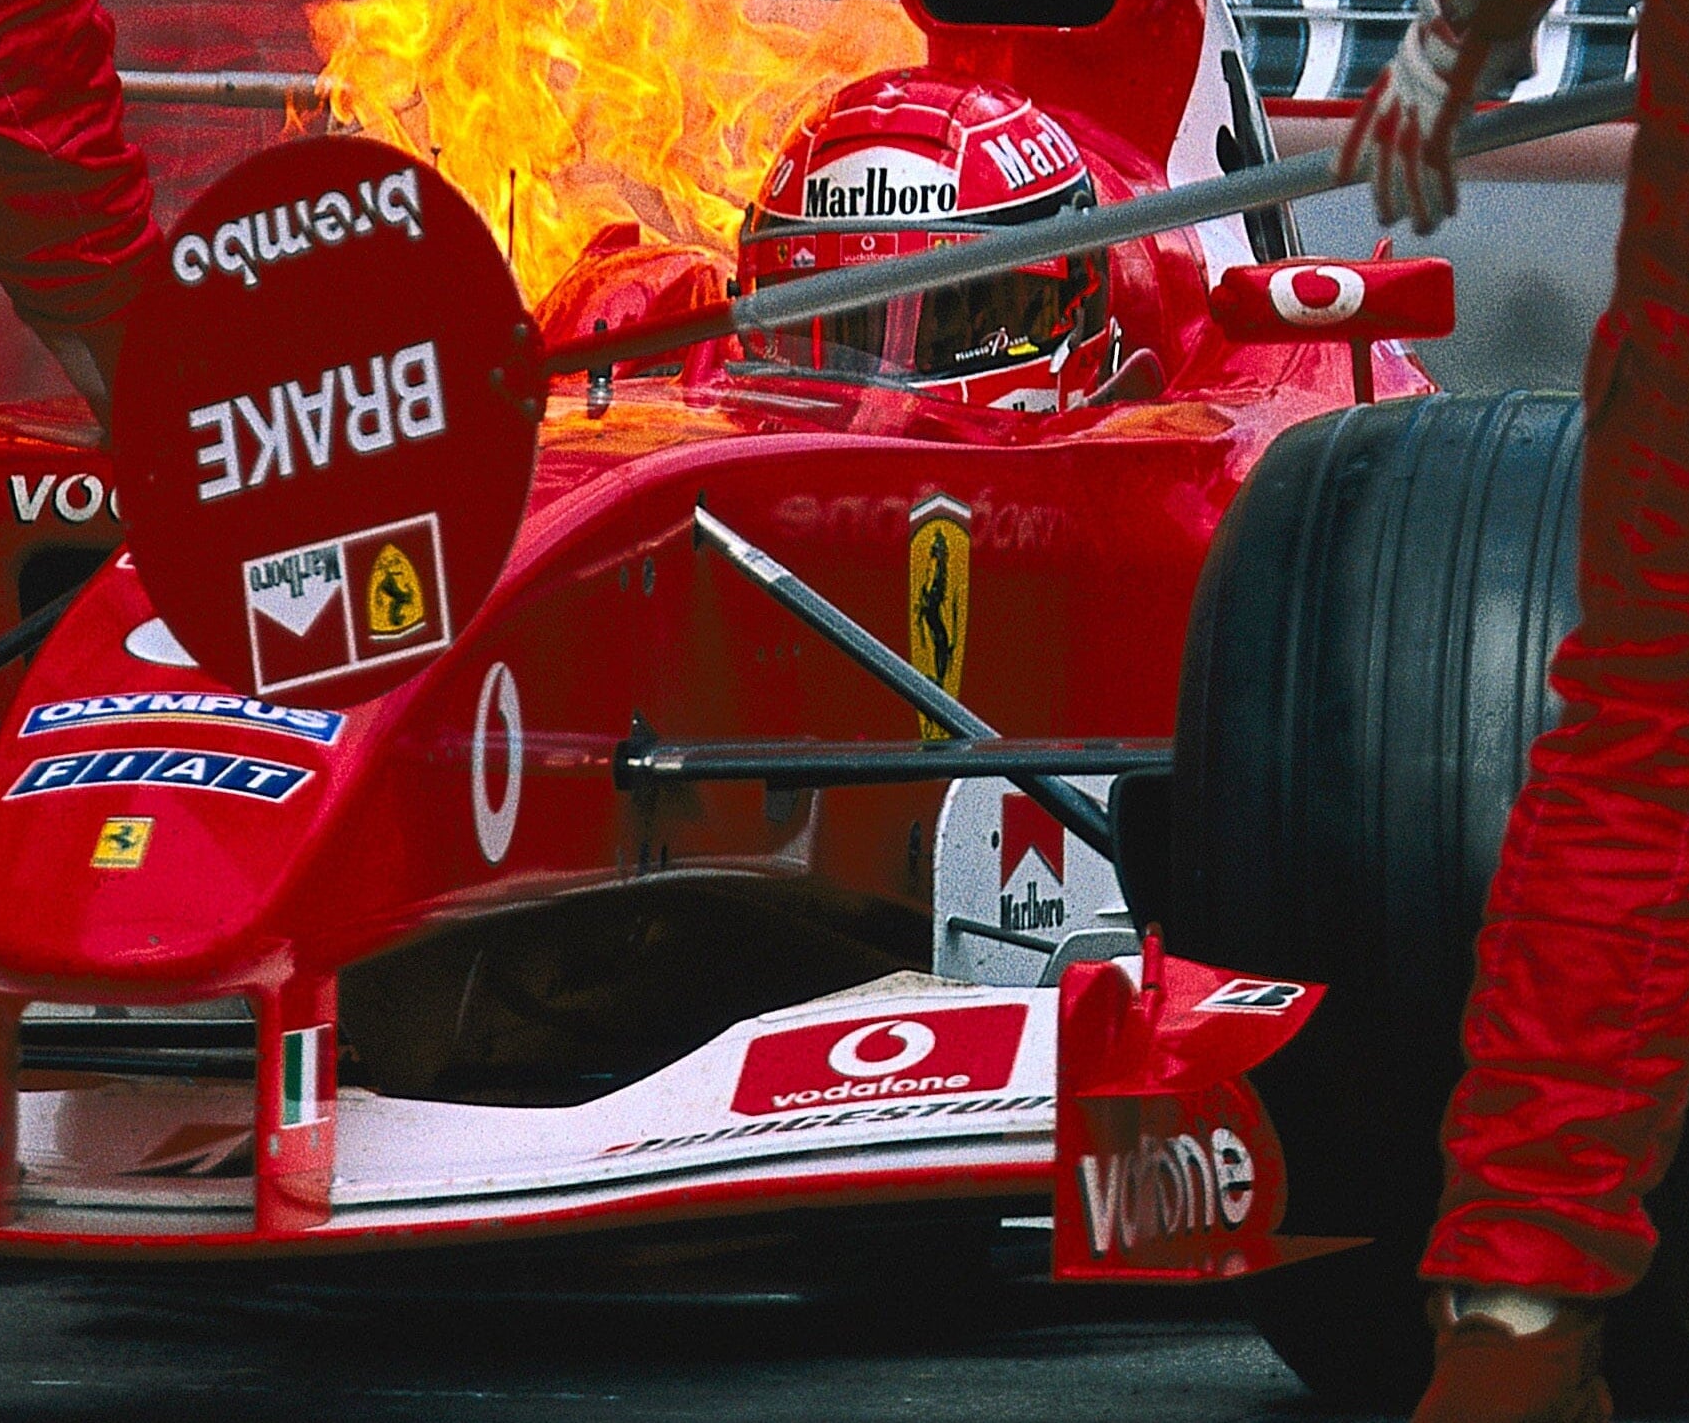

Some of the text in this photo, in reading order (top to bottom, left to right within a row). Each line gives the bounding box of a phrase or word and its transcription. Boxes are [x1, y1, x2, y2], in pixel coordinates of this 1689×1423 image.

[804, 167, 957, 219] Marlboro
[171, 168, 423, 288] brembo
[188, 340, 447, 502] BRAKE
[249, 543, 342, 599] Marlboro
[36, 693, 331, 731] OLYMPUS
[33, 750, 291, 792] FIAT
[1000, 893, 1066, 931] Marlboro
[771, 1073, 972, 1110] vodafone
